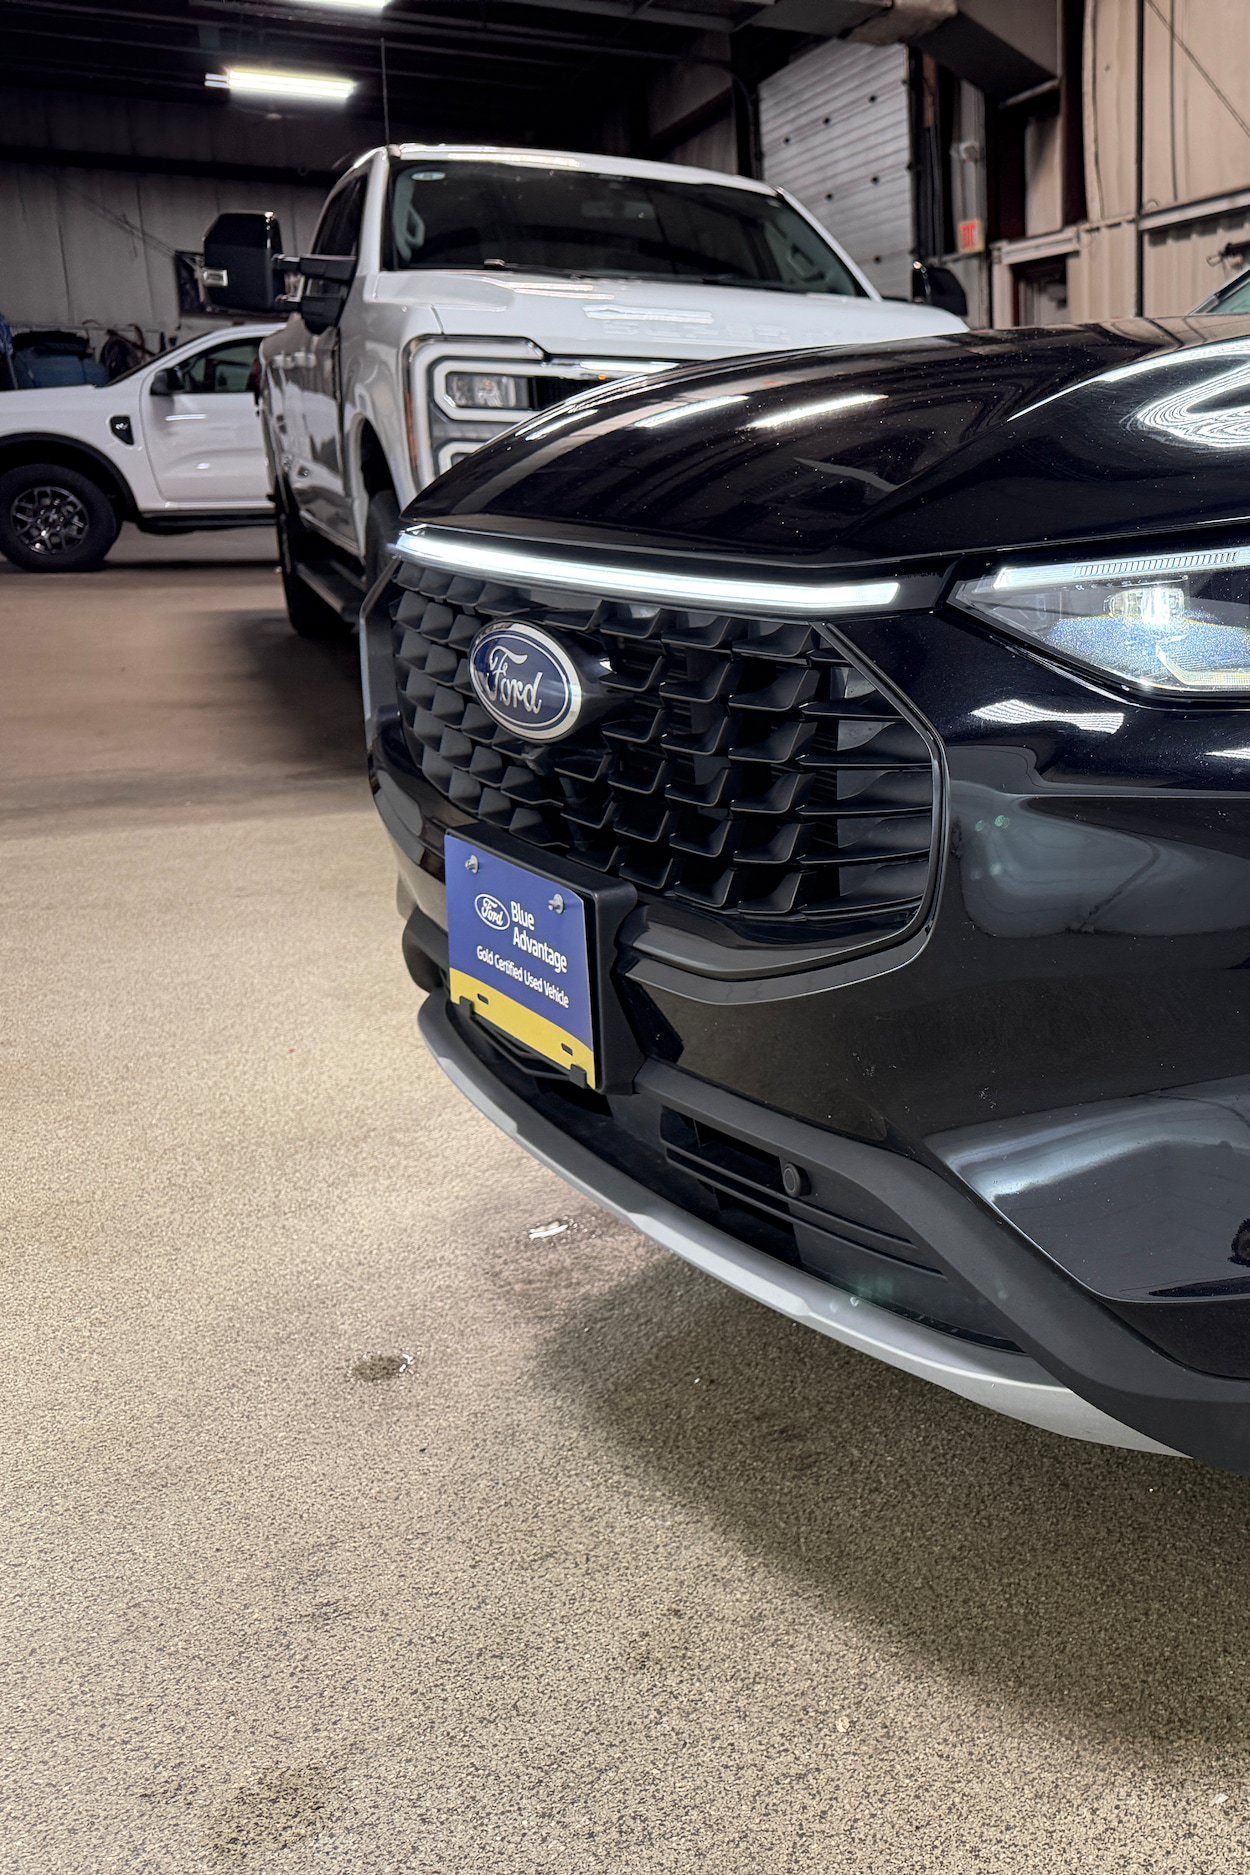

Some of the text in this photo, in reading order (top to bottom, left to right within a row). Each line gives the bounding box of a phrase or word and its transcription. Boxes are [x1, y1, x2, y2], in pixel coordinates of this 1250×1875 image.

[486, 645, 543, 715] Ford
[481, 897, 504, 927] Ford
[510, 901, 535, 930] Blue
[513, 927, 568, 974] Advantage
[477, 946, 569, 1008] Gold Certified Used Vehicle
